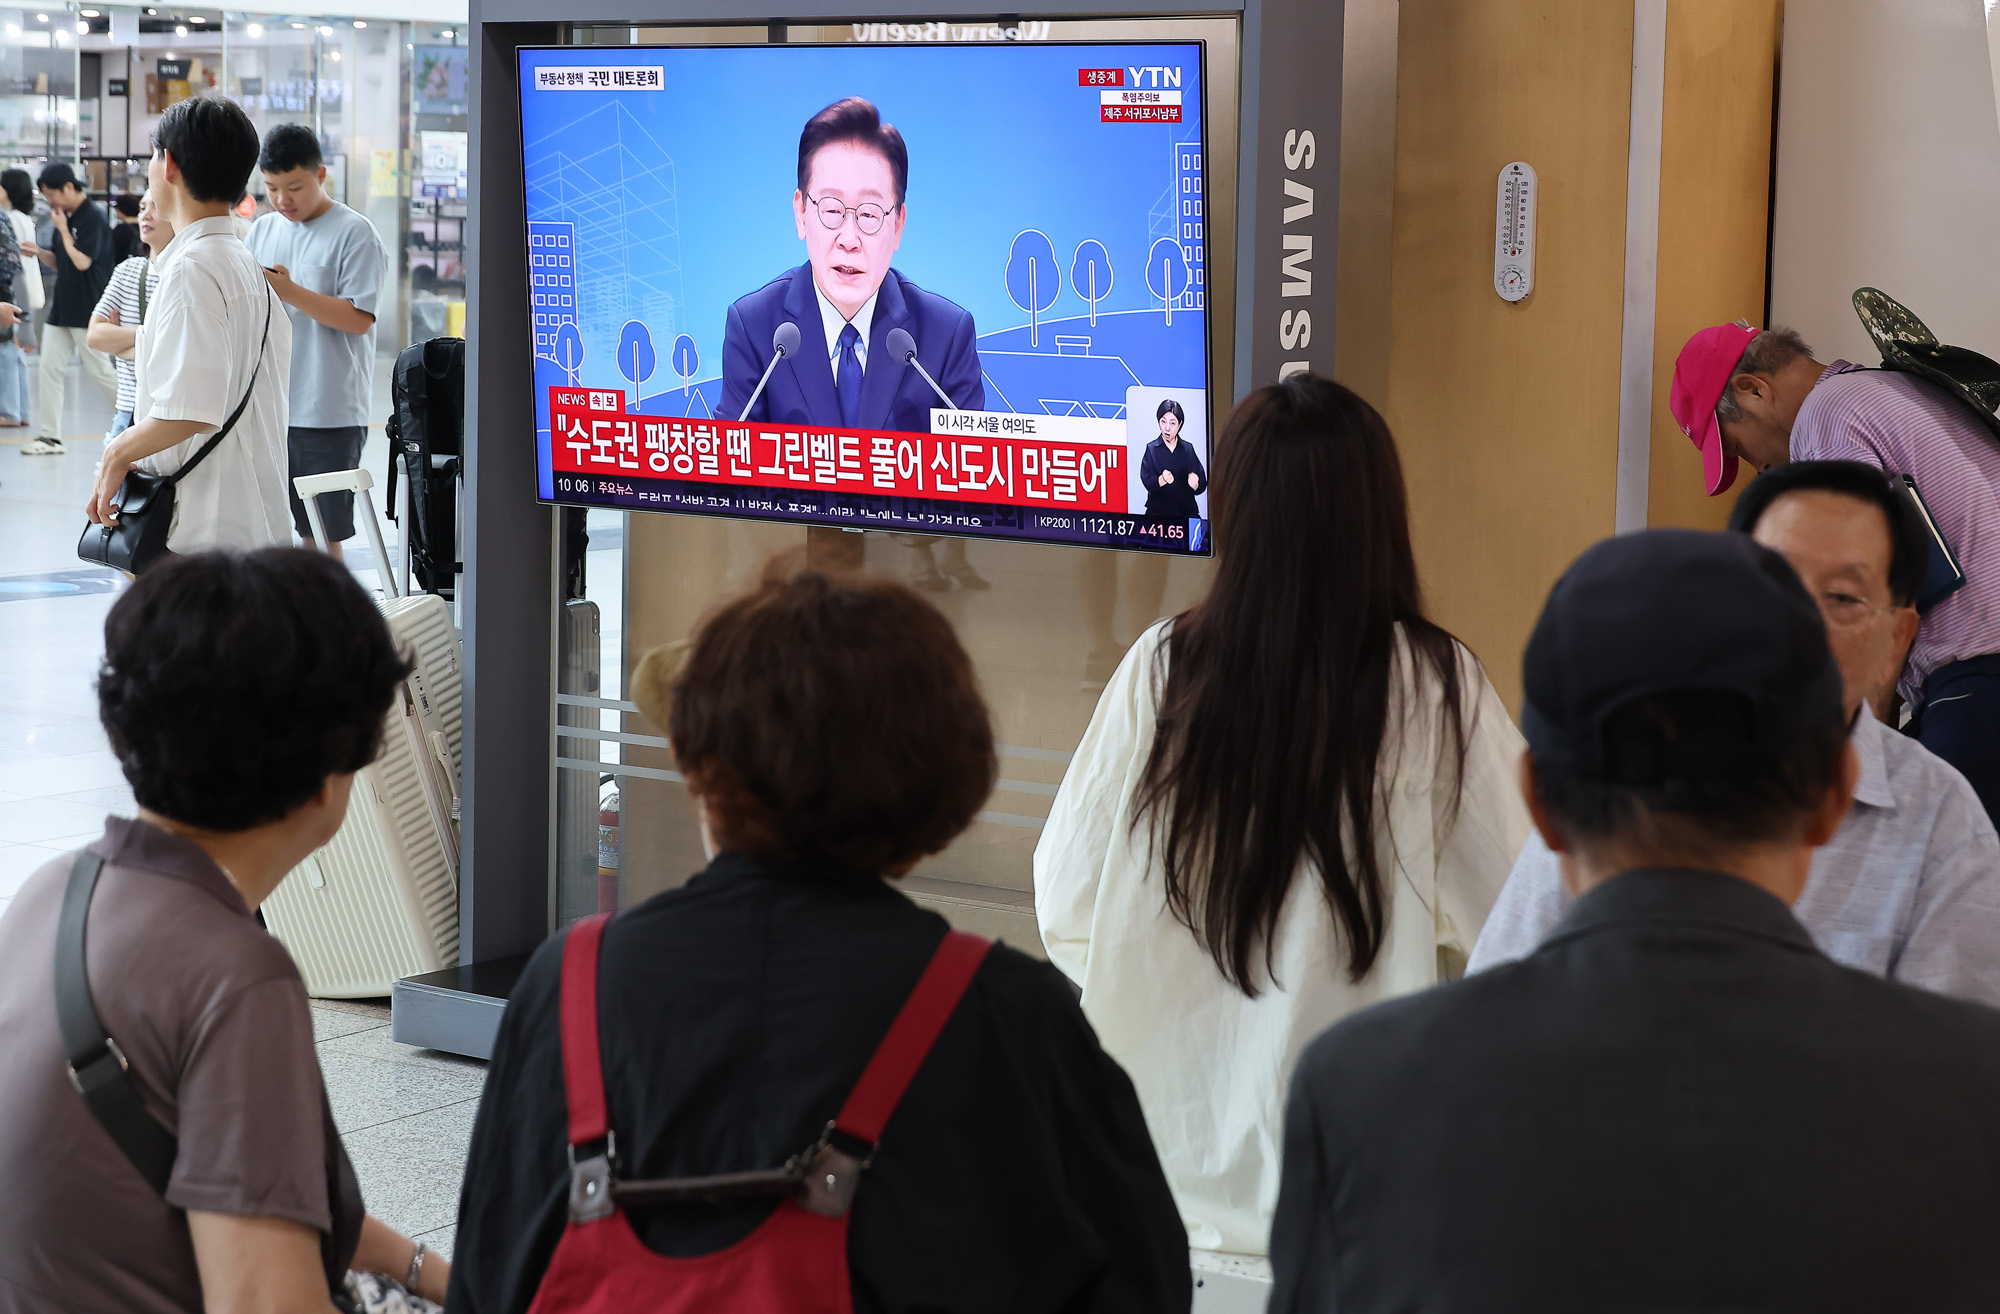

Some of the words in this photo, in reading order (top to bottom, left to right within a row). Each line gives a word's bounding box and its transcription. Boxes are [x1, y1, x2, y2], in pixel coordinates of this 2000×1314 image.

[540, 72, 565, 85] 부동산
[567, 72, 584, 85] 정책
[588, 71, 610, 86] 국민
[613, 70, 658, 86] 대토론회
[1087, 70, 1116, 84] 생중계
[1127, 66, 1182, 88] YTN
[1122, 92, 1160, 103] 폭염주의보
[1104, 107, 1122, 120] 제주
[1124, 107, 1179, 120] 서귀포시남부
[557, 392, 586, 406] NEWS
[938, 414, 950, 430] 이
[951, 414, 975, 432] 시각
[976, 416, 1000, 433] 서울
[1002, 417, 1037, 435] 여의도
[557, 413, 640, 469] "수도권
[644, 422, 721, 476] 팽창할
[726, 428, 753, 478] 땐
[758, 431, 864, 485] 그린벨트
[869, 437, 924, 491] 풀어
[930, 440, 1014, 498] 신도시
[1022, 447, 1119, 505] 만들어"
[557, 478, 571, 492] 10
[575, 479, 589, 493] 06
[598, 481, 634, 496] 주요뉴스
[1040, 516, 1070, 529] KP200
[1080, 517, 1135, 537] 1121.87
